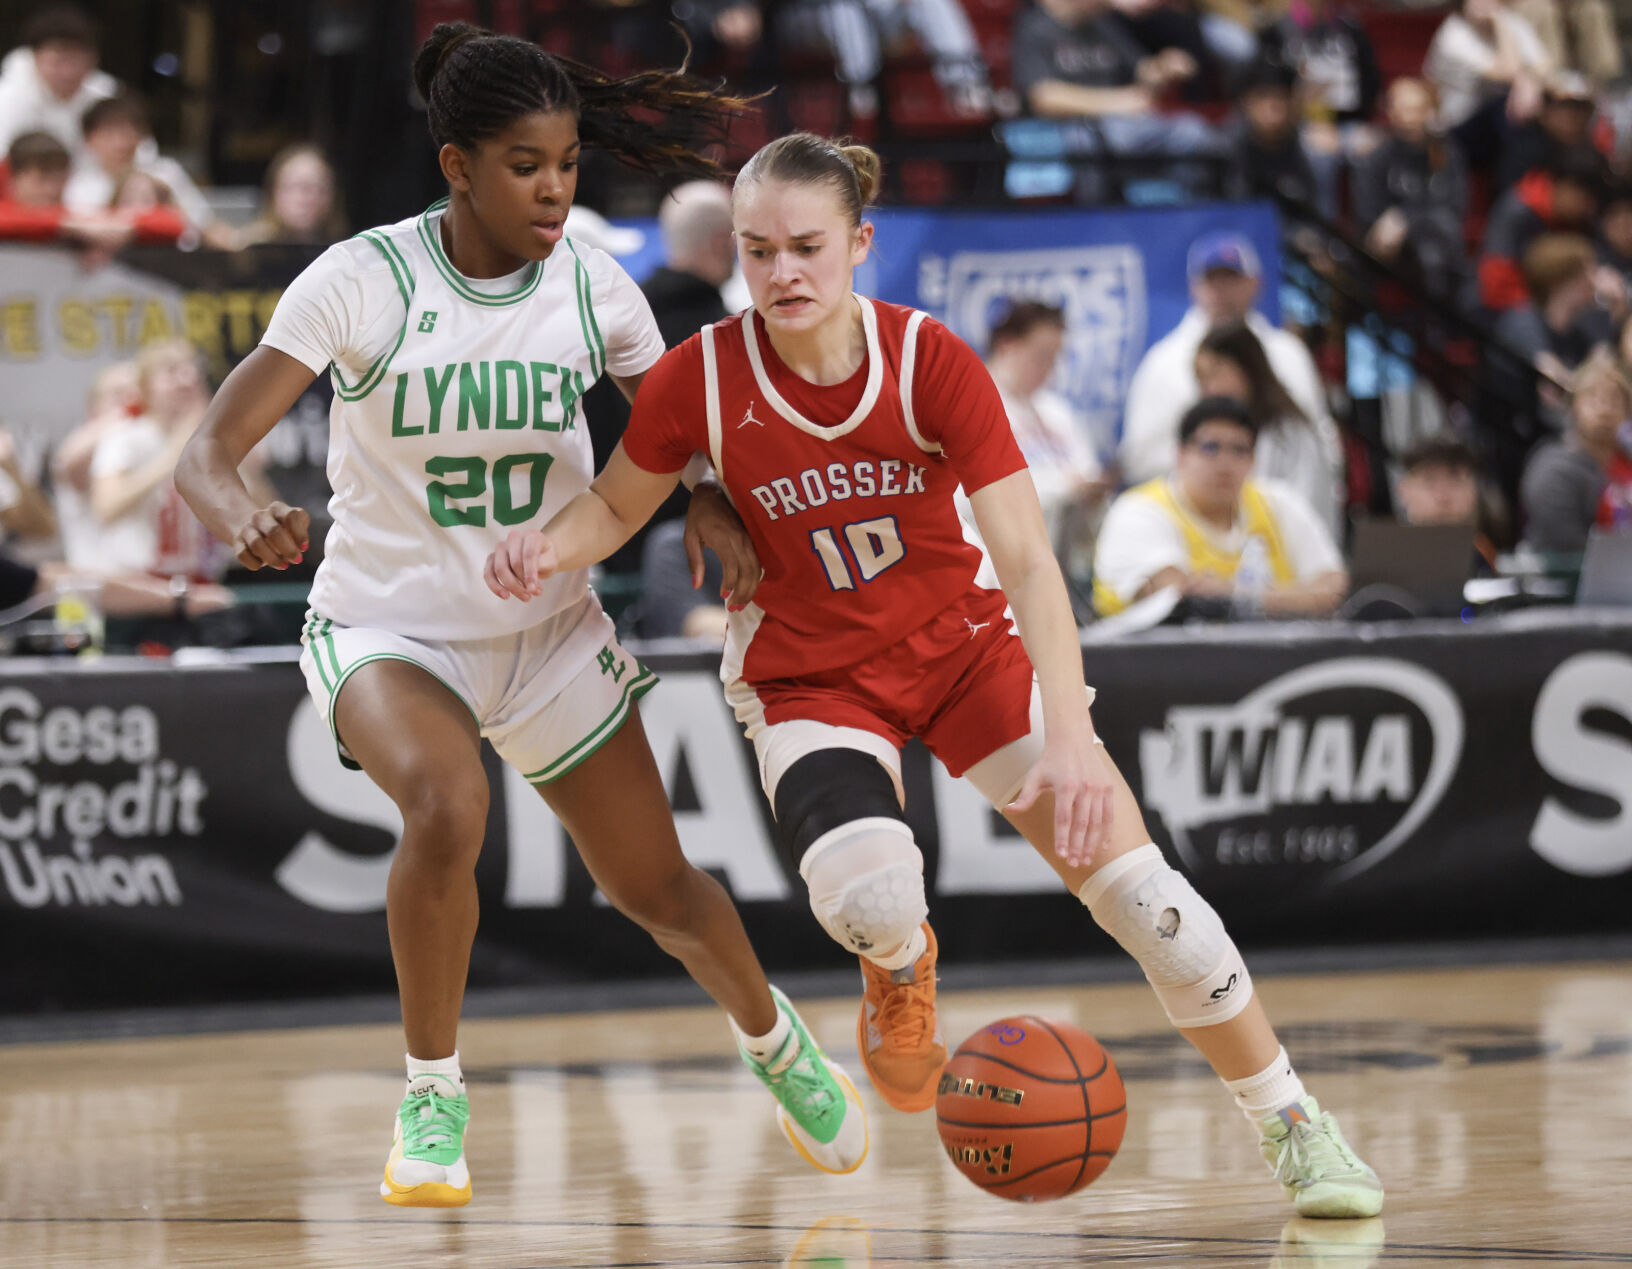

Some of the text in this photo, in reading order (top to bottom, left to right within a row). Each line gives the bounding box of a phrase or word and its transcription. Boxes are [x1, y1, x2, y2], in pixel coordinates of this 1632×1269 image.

[425, 452, 554, 528] 20
[808, 514, 907, 592] 10
[0, 687, 159, 765] Gesa
[1199, 713, 1413, 804] WIAA
[0, 761, 208, 840] Credit
[2, 836, 182, 908] Union
